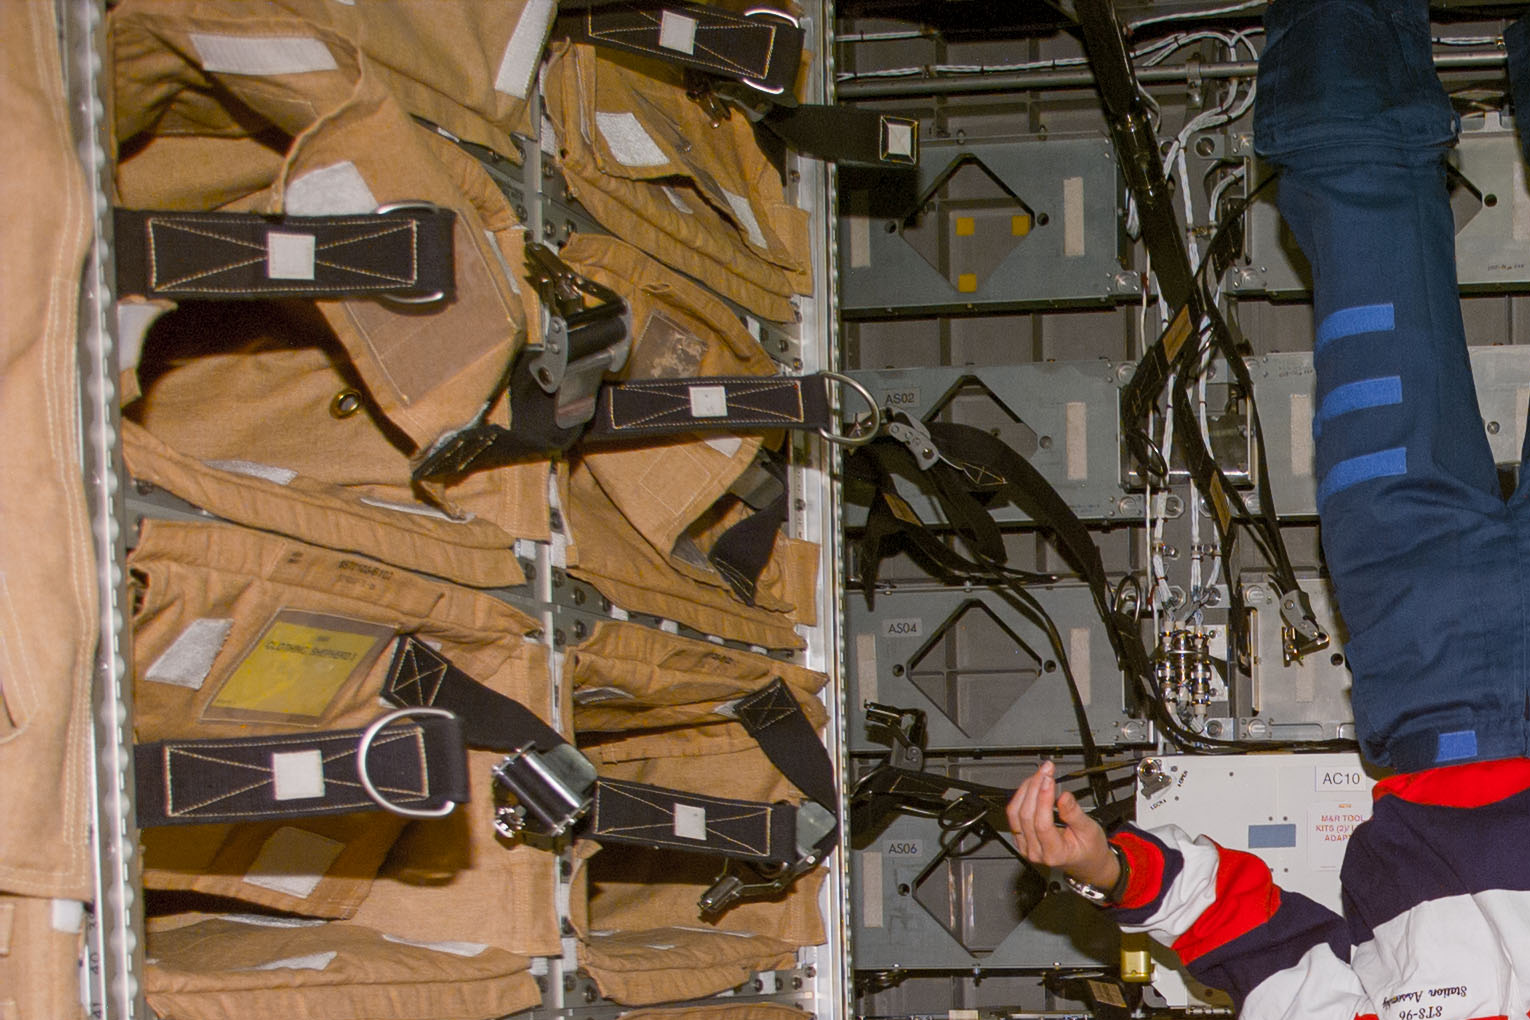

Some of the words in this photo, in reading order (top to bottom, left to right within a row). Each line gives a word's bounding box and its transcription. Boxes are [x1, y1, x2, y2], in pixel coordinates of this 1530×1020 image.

[888, 622, 917, 634] AS04
[1322, 772, 1360, 785] AC10
[888, 843, 918, 855] AS06
[1428, 985, 1467, 999] Station
